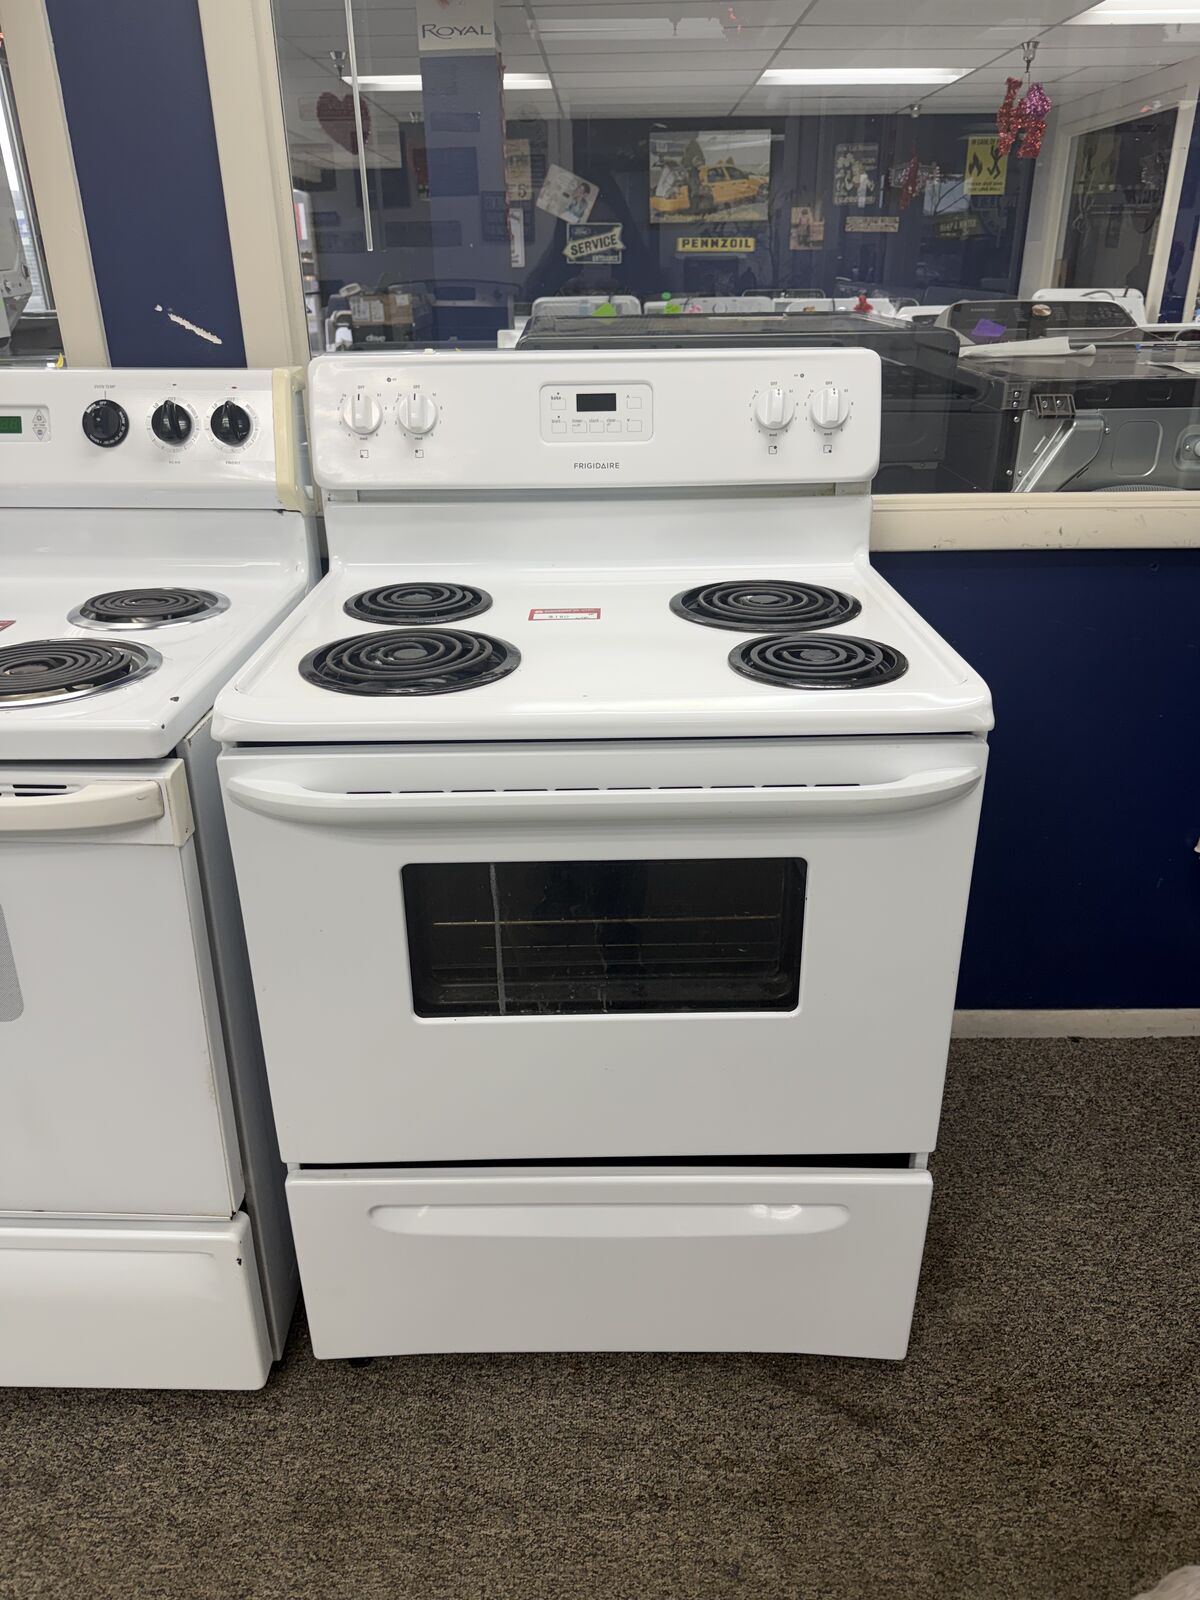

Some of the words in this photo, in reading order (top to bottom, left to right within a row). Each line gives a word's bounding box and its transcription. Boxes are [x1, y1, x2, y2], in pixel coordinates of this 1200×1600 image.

[422, 23, 492, 40] ROYAL
[570, 233, 618, 256] SERVICE
[681, 239, 752, 249] PENNZOIL
[573, 462, 620, 470] FRIGIDAIRE
